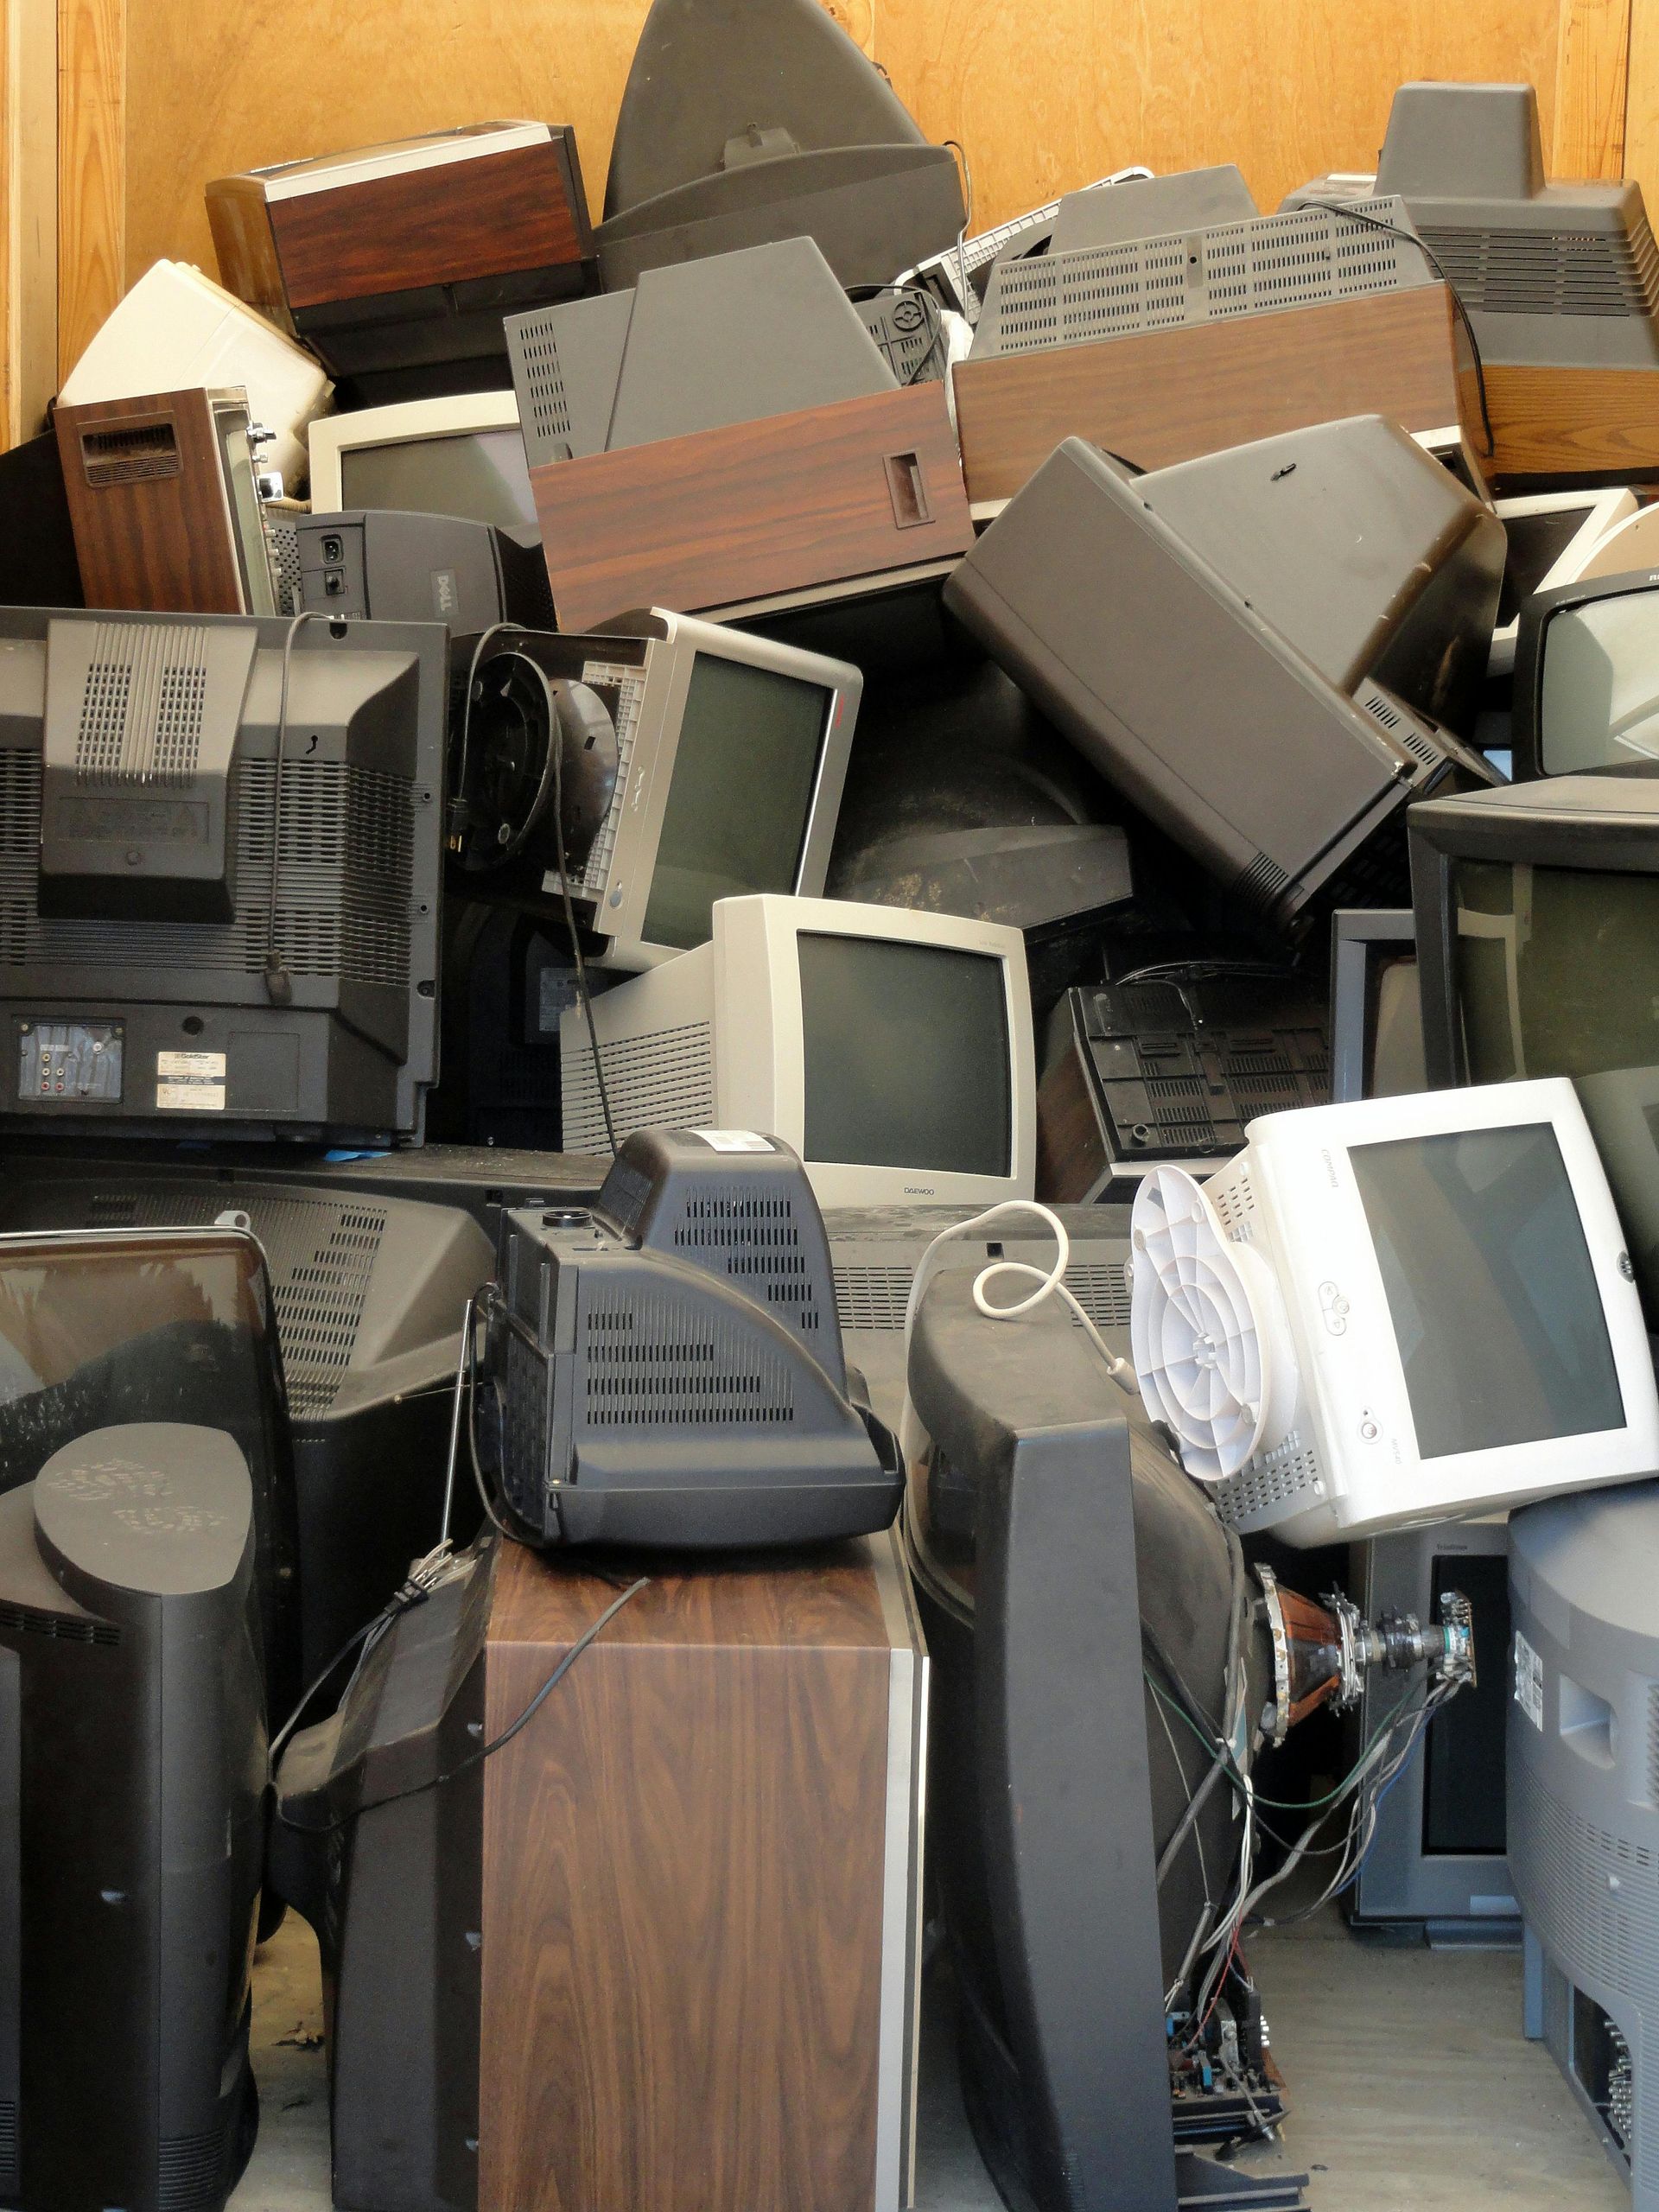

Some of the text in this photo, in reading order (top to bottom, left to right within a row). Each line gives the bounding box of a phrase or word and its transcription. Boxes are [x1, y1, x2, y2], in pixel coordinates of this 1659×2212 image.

[437, 574, 452, 611] DELL
[1321, 1149, 1339, 1188] COMPAQ
[904, 1187, 935, 1196] DAEWOO
